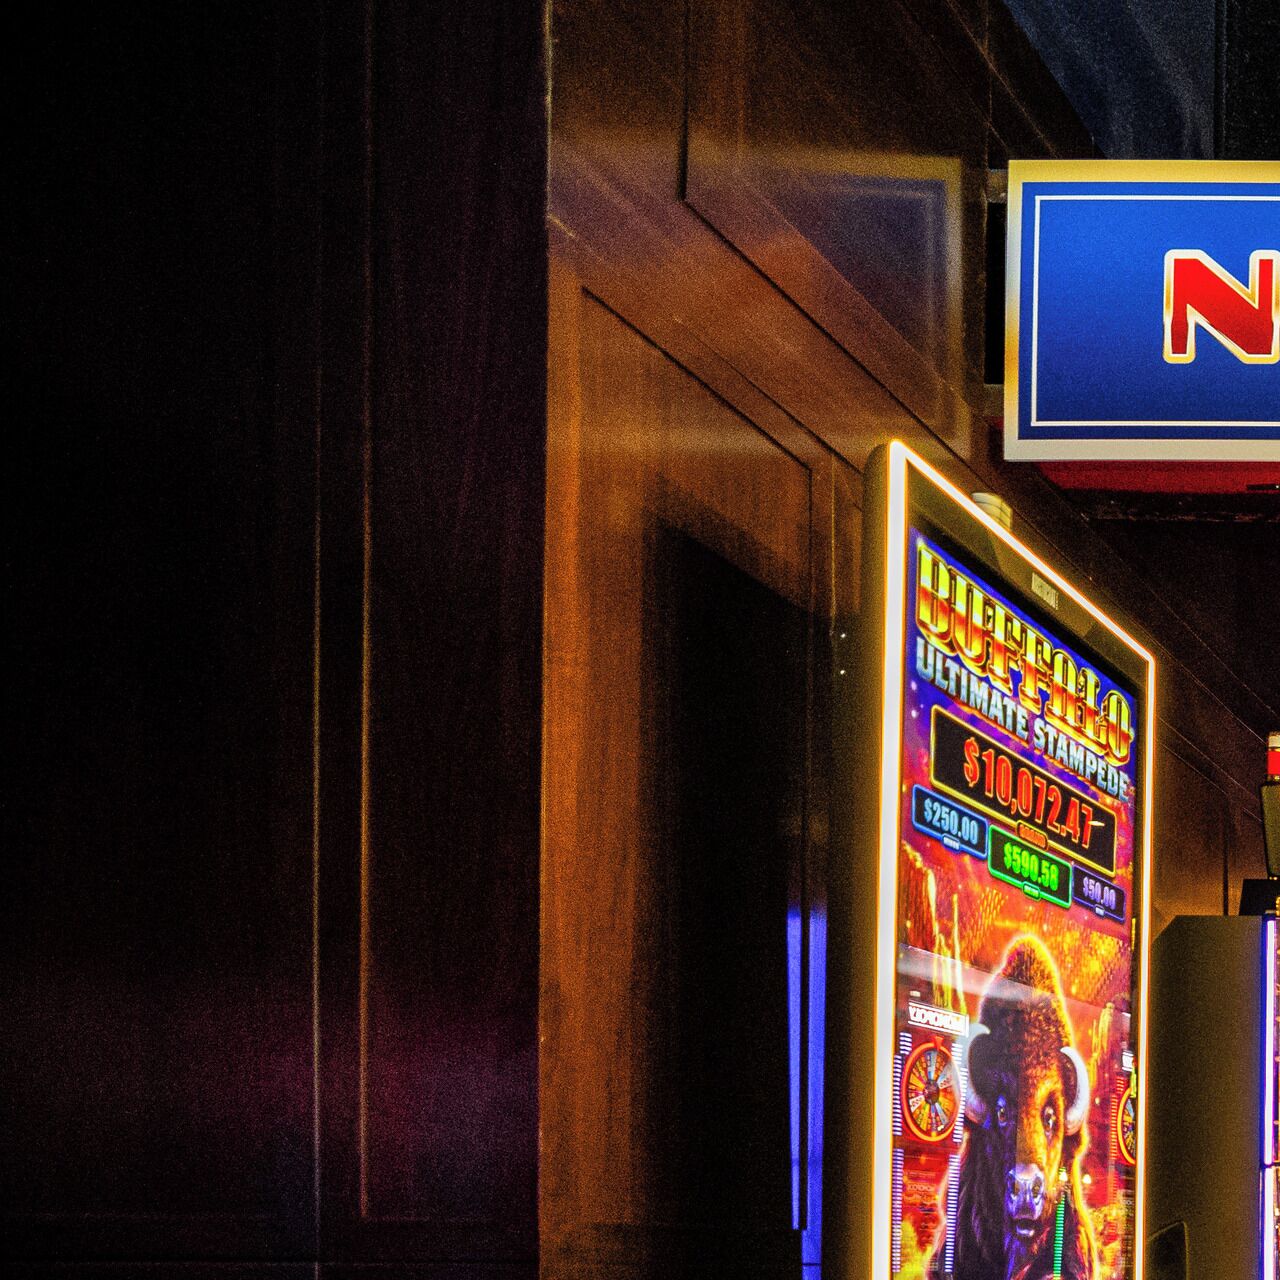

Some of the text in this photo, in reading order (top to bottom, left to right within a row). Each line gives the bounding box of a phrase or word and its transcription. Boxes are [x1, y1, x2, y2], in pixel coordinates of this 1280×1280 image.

[915, 636, 1131, 802] ULTIMATE STAMPEDE
[916, 540, 1134, 767] BUFFALO
[923, 798, 979, 845] $250.00
[963, 737, 1095, 849] $10,072.47
